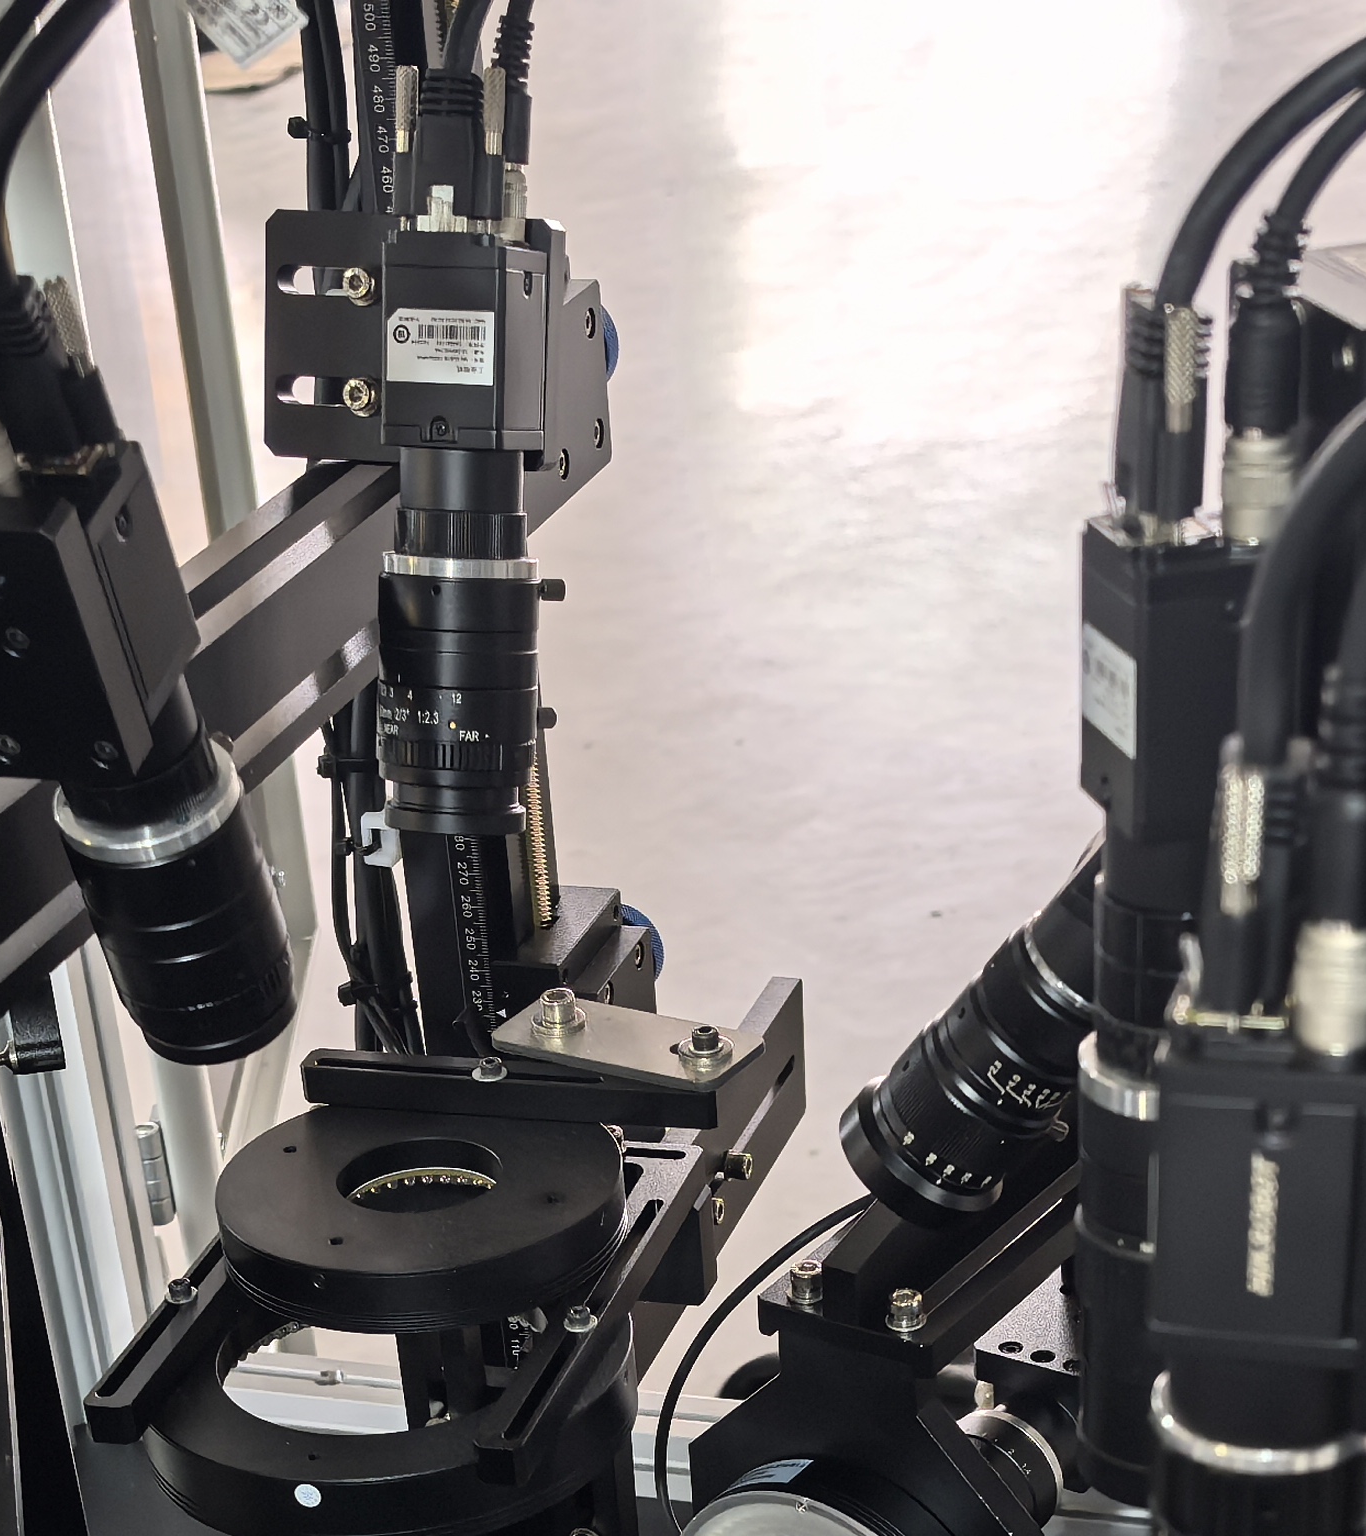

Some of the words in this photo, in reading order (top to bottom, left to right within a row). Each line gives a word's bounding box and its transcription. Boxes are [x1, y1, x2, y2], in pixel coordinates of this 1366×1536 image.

[363, 3, 377, 32] 500
[367, 44, 381, 73] 490
[372, 85, 385, 113] 480
[377, 125, 390, 154] 470
[380, 165, 394, 193] 460
[451, 692, 463, 705] 12
[459, 730, 480, 742] FAR
[454, 835, 465, 851] 80
[457, 861, 469, 886] 270
[461, 895, 473, 919] 260
[465, 927, 476, 951] 250
[468, 959, 480, 982] 240
